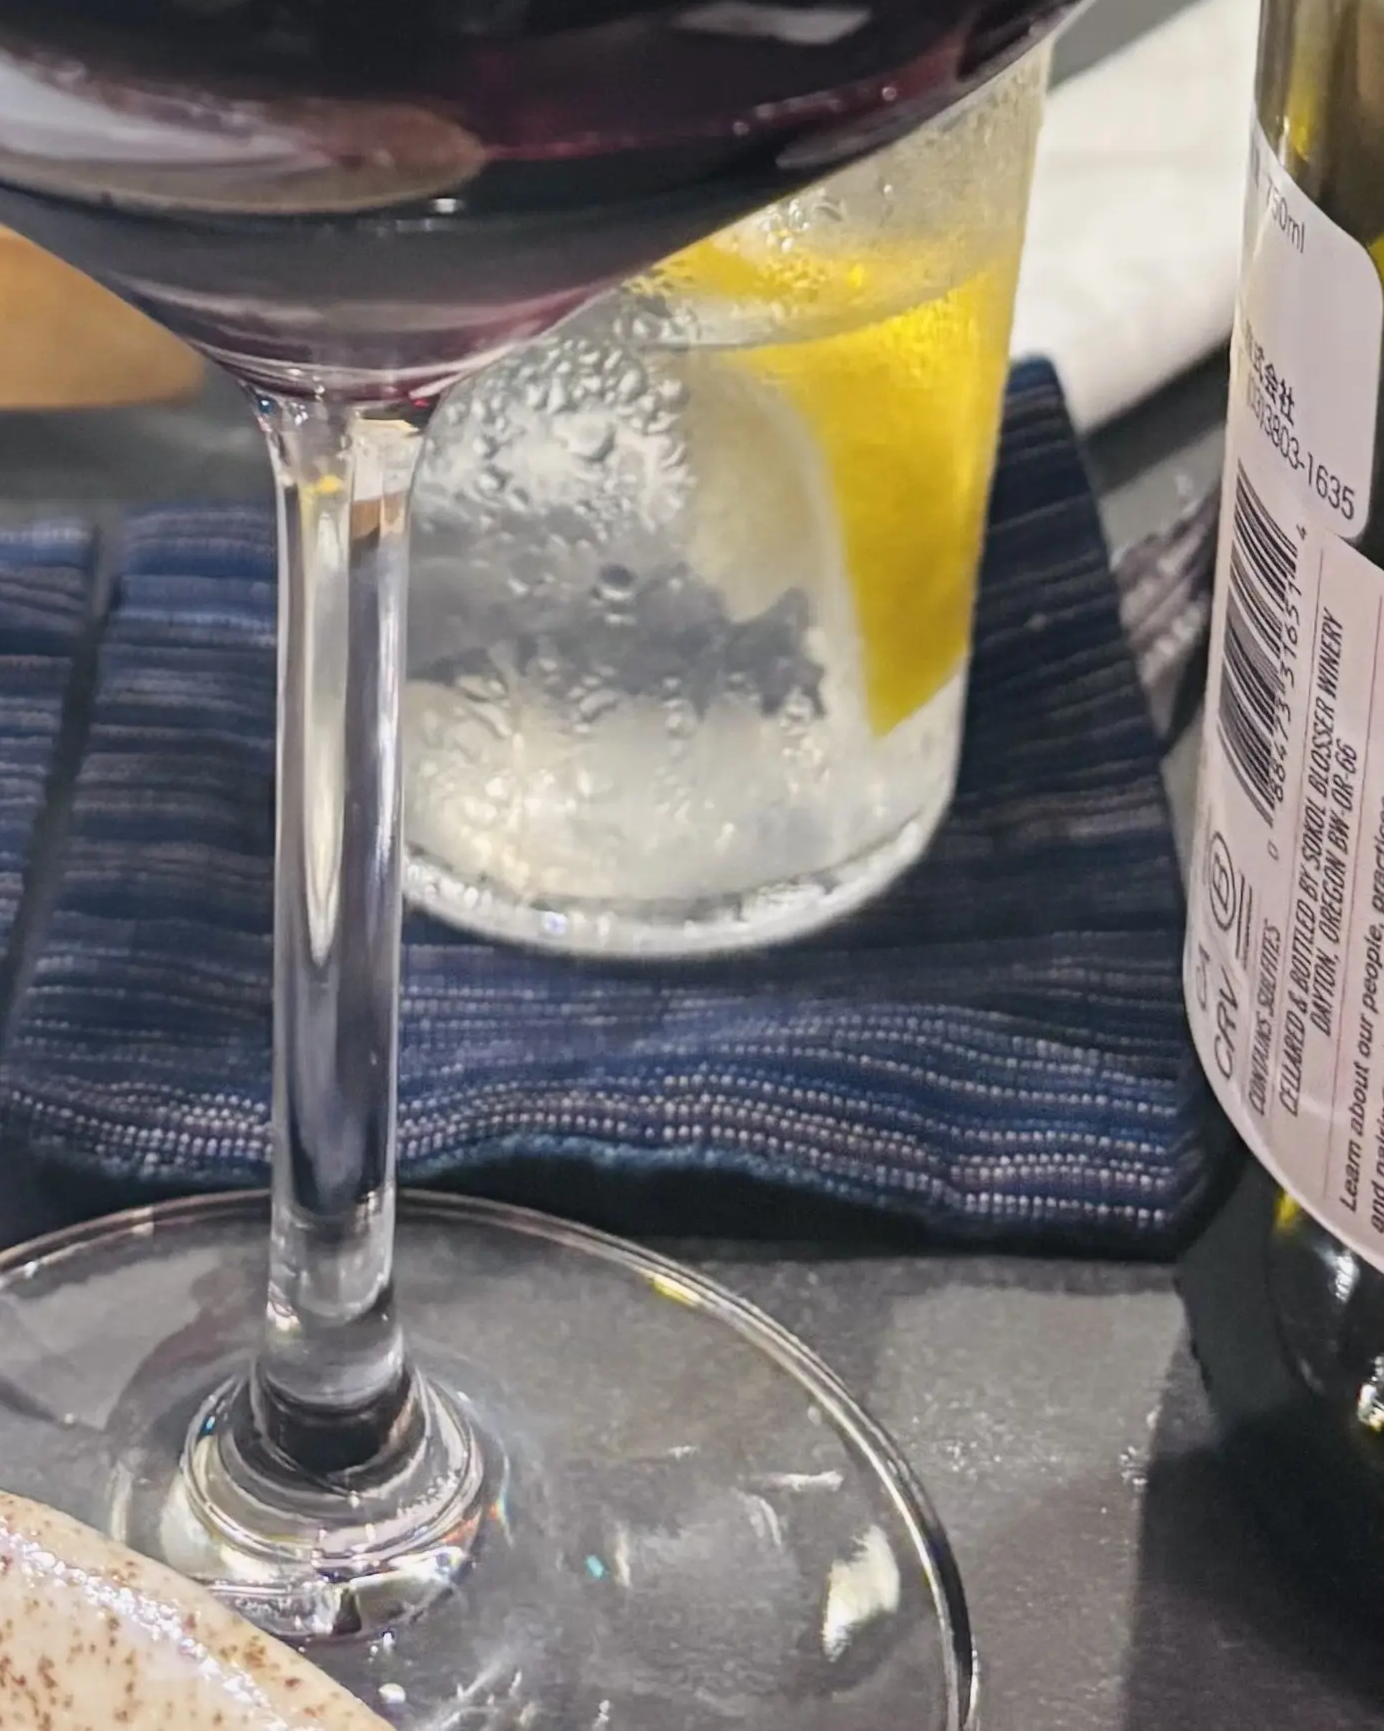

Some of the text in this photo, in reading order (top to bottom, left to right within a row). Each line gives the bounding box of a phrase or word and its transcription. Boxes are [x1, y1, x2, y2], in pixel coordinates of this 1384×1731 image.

[1278, 605, 1344, 1118] CELLARED & BOTTLED BY SOKOL BLOSSER WINERY
[1309, 738, 1358, 1039] DAYTON, OREGON BW-OR-66
[1213, 965, 1238, 1081] CRV
[1248, 917, 1281, 1117] CONTAINS SULFITES
[1357, 1012, 1375, 1059] our
[1347, 1060, 1369, 1138] about
[1339, 1139, 1363, 1214] Learn
